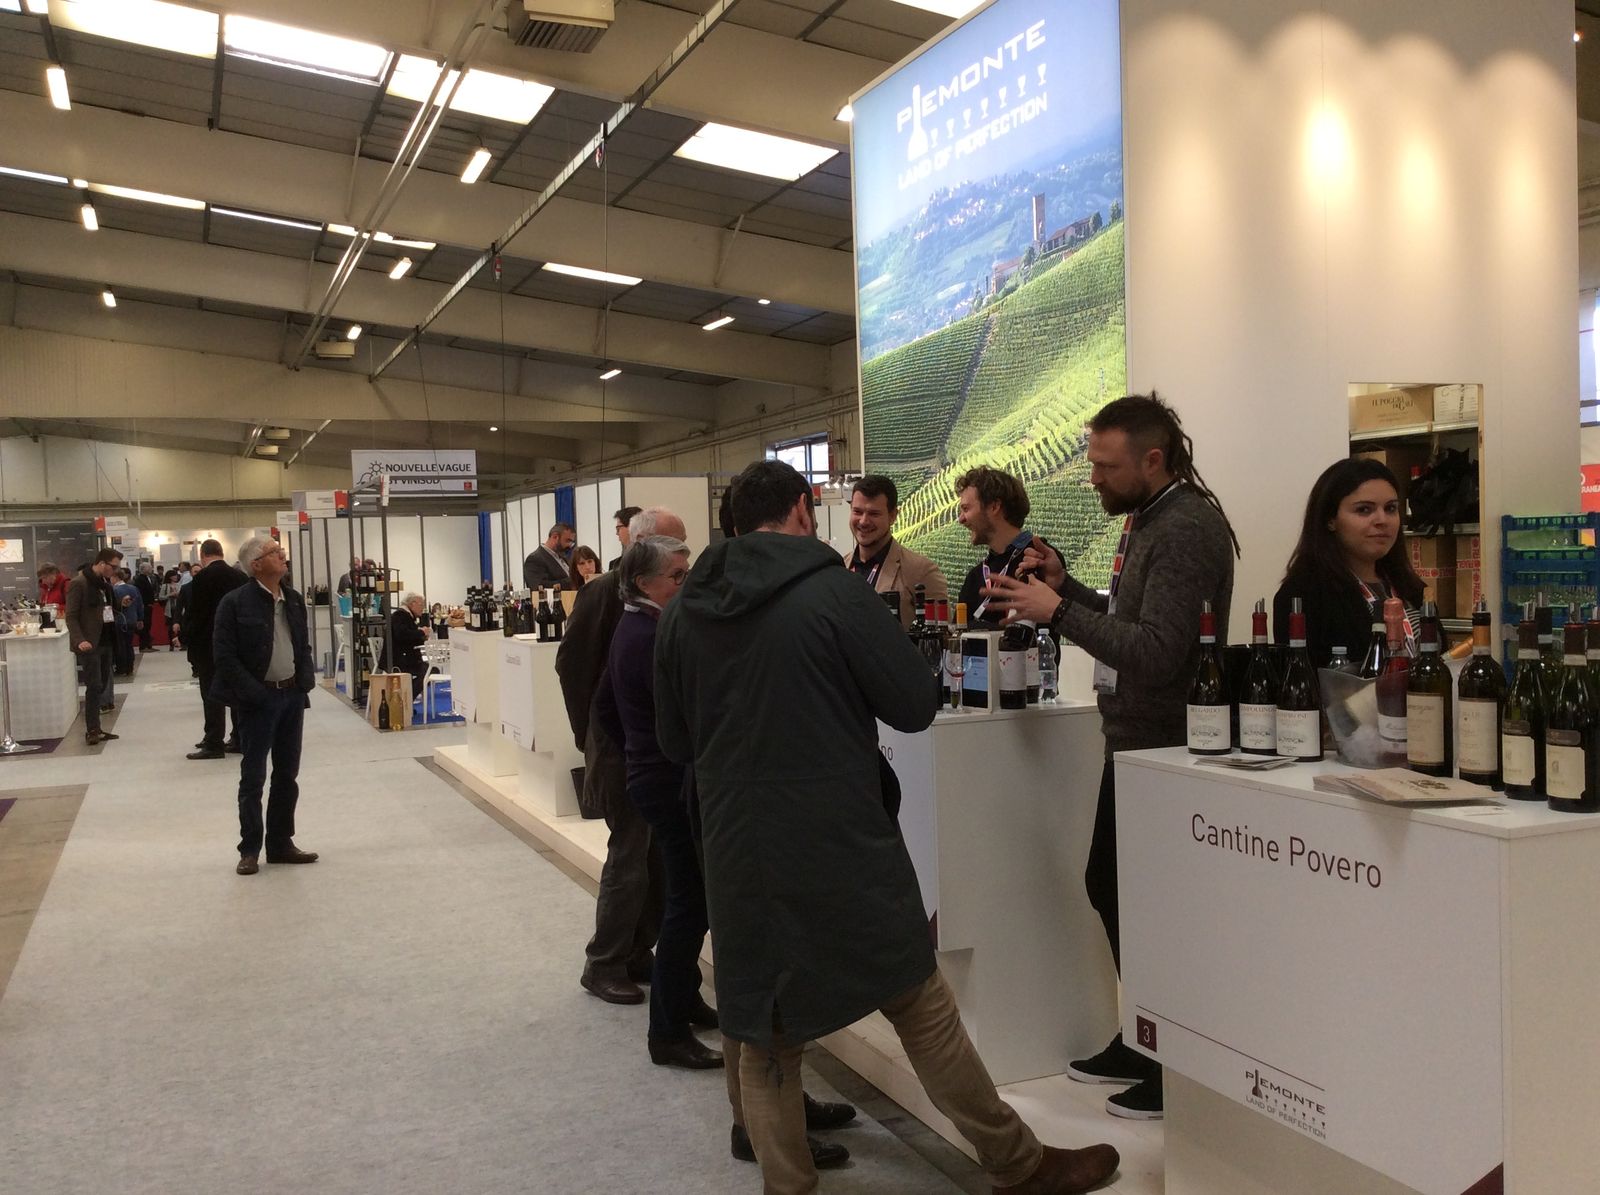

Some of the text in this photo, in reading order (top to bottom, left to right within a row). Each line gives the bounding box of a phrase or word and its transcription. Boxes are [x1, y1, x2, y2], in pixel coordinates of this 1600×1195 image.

[896, 19, 1046, 160] PIEMONTE
[897, 92, 1048, 190] LAND OF PERFECTION
[385, 463, 471, 473] NOUVELLE VAGUE
[1191, 813, 1382, 889] Cantine Povero
[1143, 1024, 1152, 1044] 3
[1245, 1069, 1326, 1115] PIEMONTE
[1245, 1095, 1327, 1140] LAND OF PERFECTION
